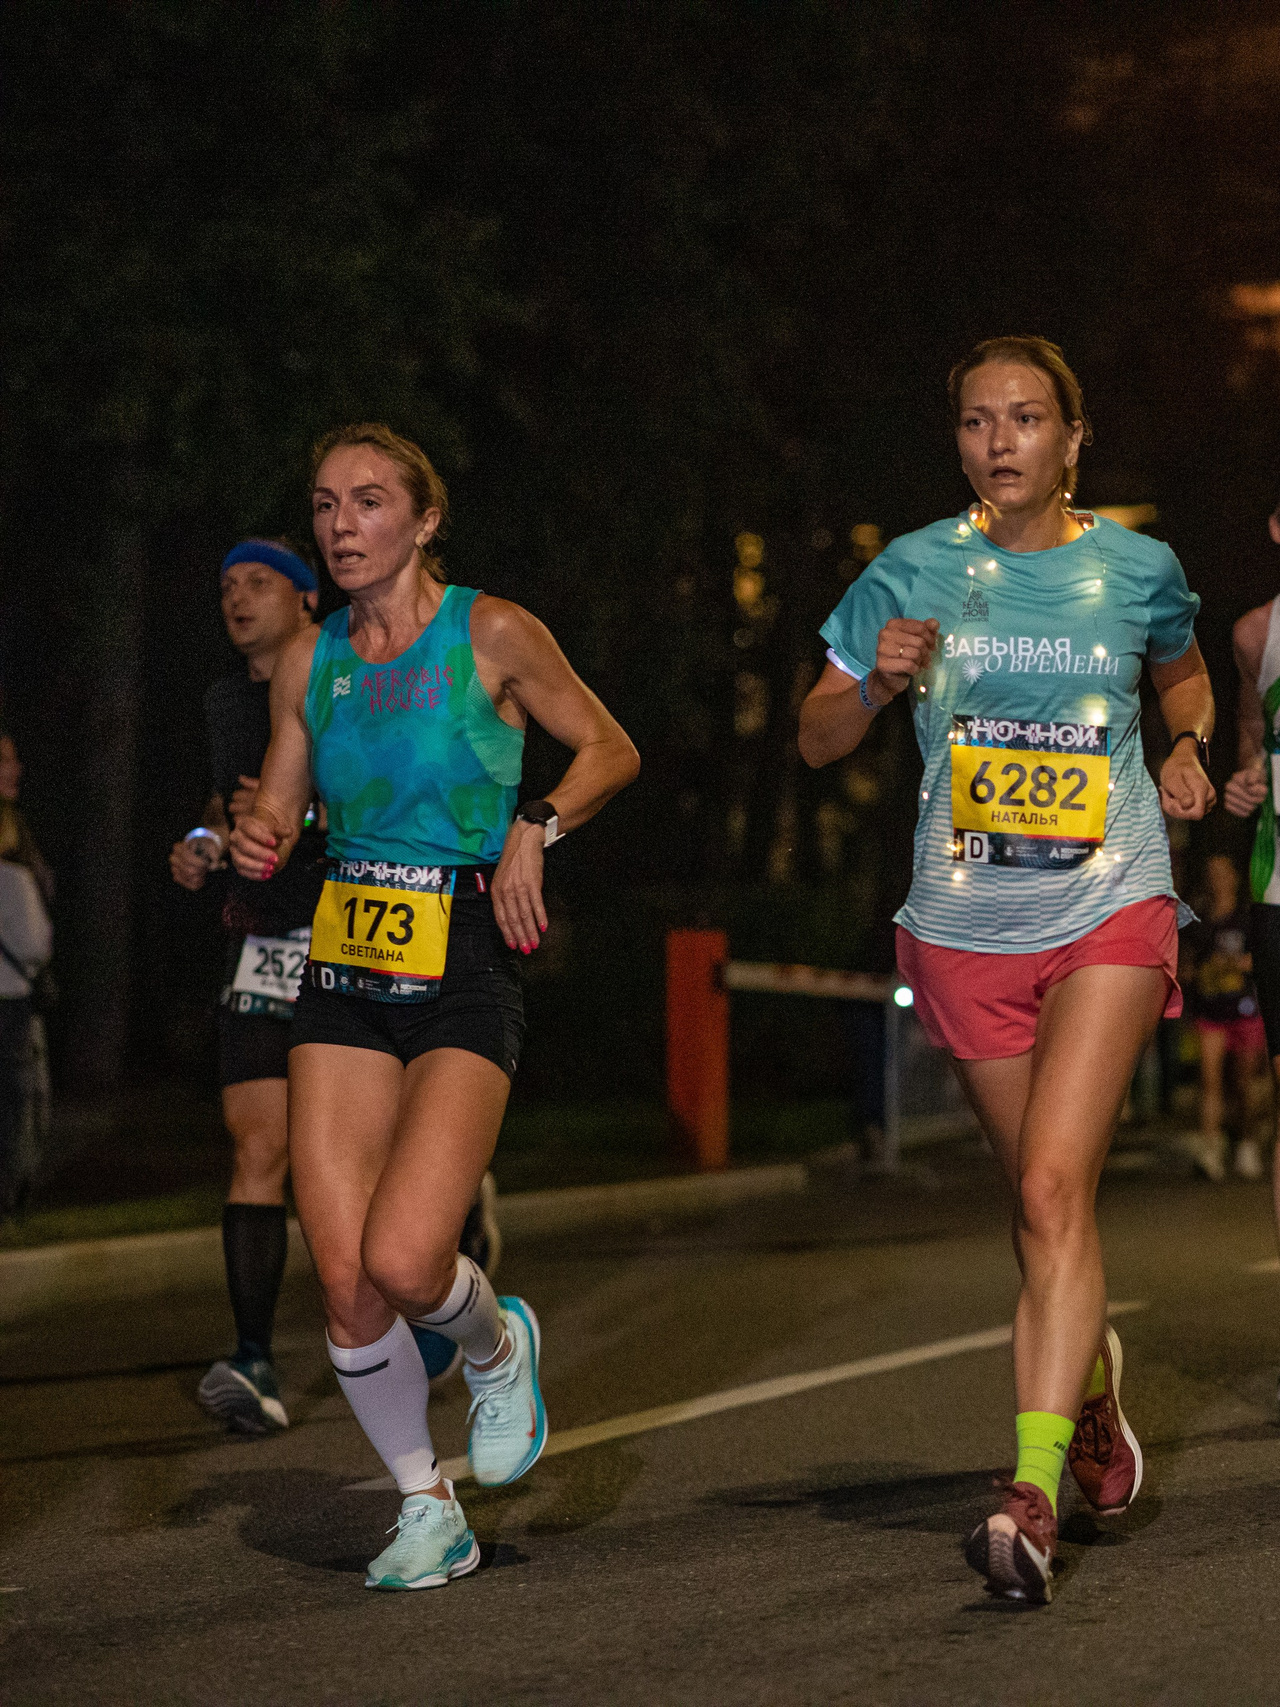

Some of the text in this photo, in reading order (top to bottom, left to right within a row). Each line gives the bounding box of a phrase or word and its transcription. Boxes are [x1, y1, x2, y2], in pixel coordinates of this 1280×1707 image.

[944, 636, 1071, 658] ЗАБЫВАЯ
[984, 652, 1120, 676] О ВРЕМЕНИ
[361, 664, 455, 697] AEROBIC
[369, 686, 441, 716] HOUSE
[969, 760, 1089, 812] 6282
[990, 810, 1059, 827] НАТАЛЬЯ
[969, 835, 984, 860] D
[343, 896, 416, 947] 173
[340, 942, 405, 964] СВЕТЛАНА
[320, 966, 336, 991] D
